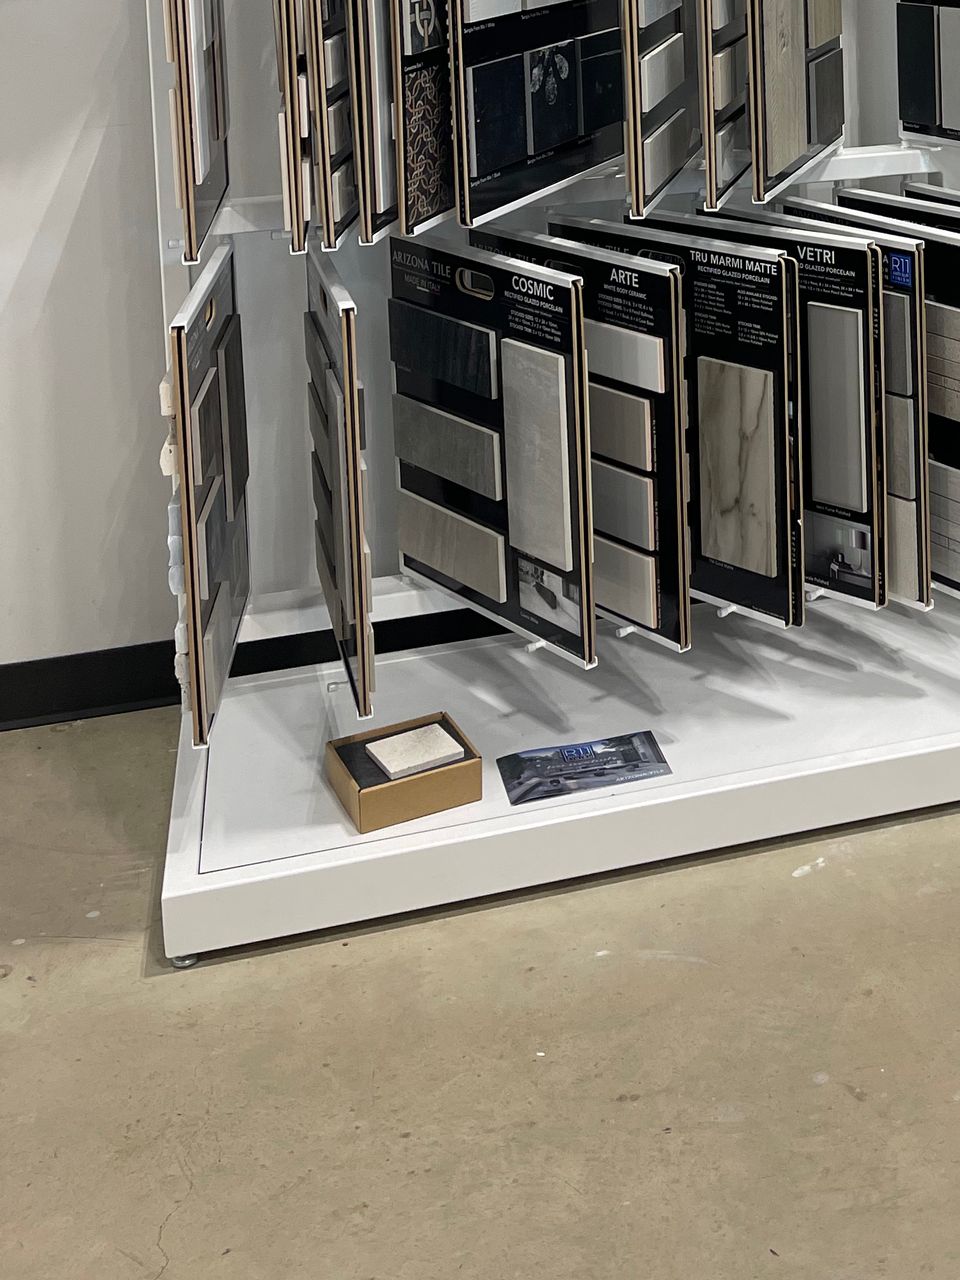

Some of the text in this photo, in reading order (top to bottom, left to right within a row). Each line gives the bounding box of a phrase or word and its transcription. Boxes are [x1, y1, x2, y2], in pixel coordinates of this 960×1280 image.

[392, 249, 451, 278] ARIZONA TILE
[689, 250, 778, 276] TRU MARMI MATTE
[797, 245, 835, 265] VETRI
[609, 267, 640, 288] ARTE
[697, 265, 770, 284] RECTIFIED GLAZED PORCELAIN
[804, 263, 856, 278] GLAZED PORCELAIN
[511, 275, 554, 301] COSMIC
[616, 287, 628, 297] BODY
[628, 290, 647, 300] CERAMIC
[504, 290, 563, 314] RECTIFIED GLAZED PORCELAIN
